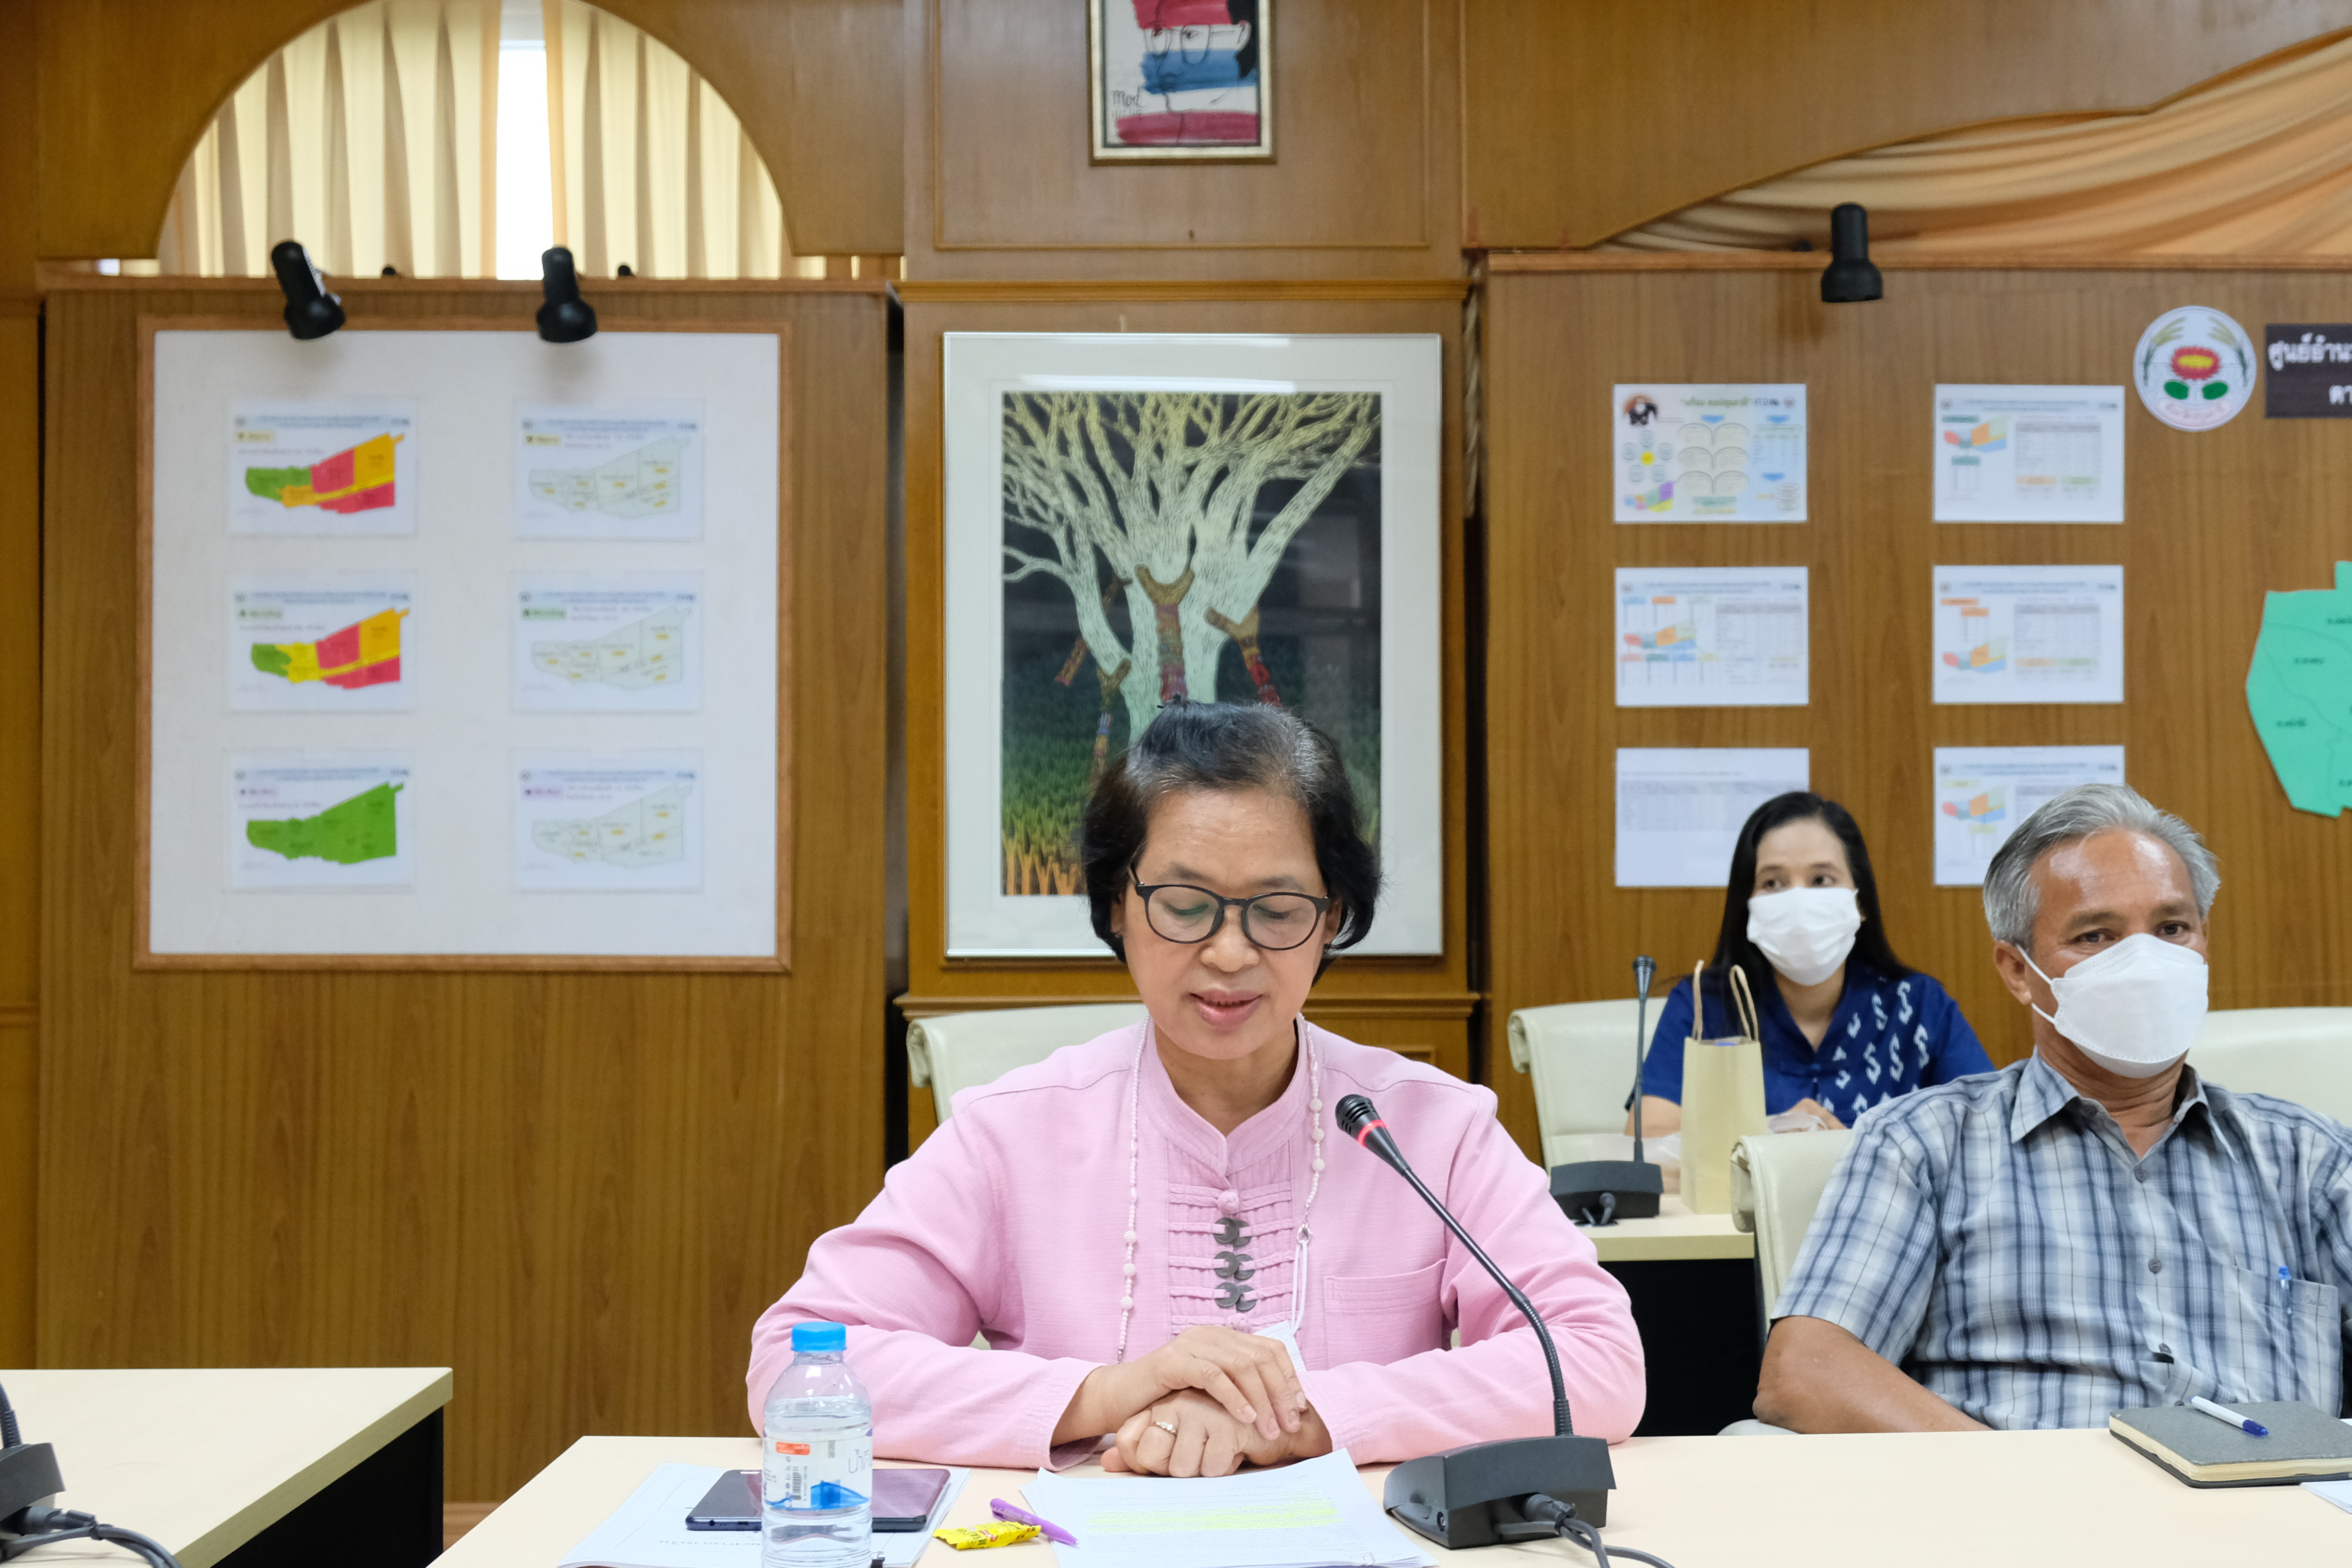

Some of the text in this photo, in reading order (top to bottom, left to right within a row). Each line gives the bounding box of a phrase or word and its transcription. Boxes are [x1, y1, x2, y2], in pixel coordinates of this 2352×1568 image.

[2268, 332, 2352, 371] ศูนย์อำน
[848, 1448, 872, 1473] น้ำดื
